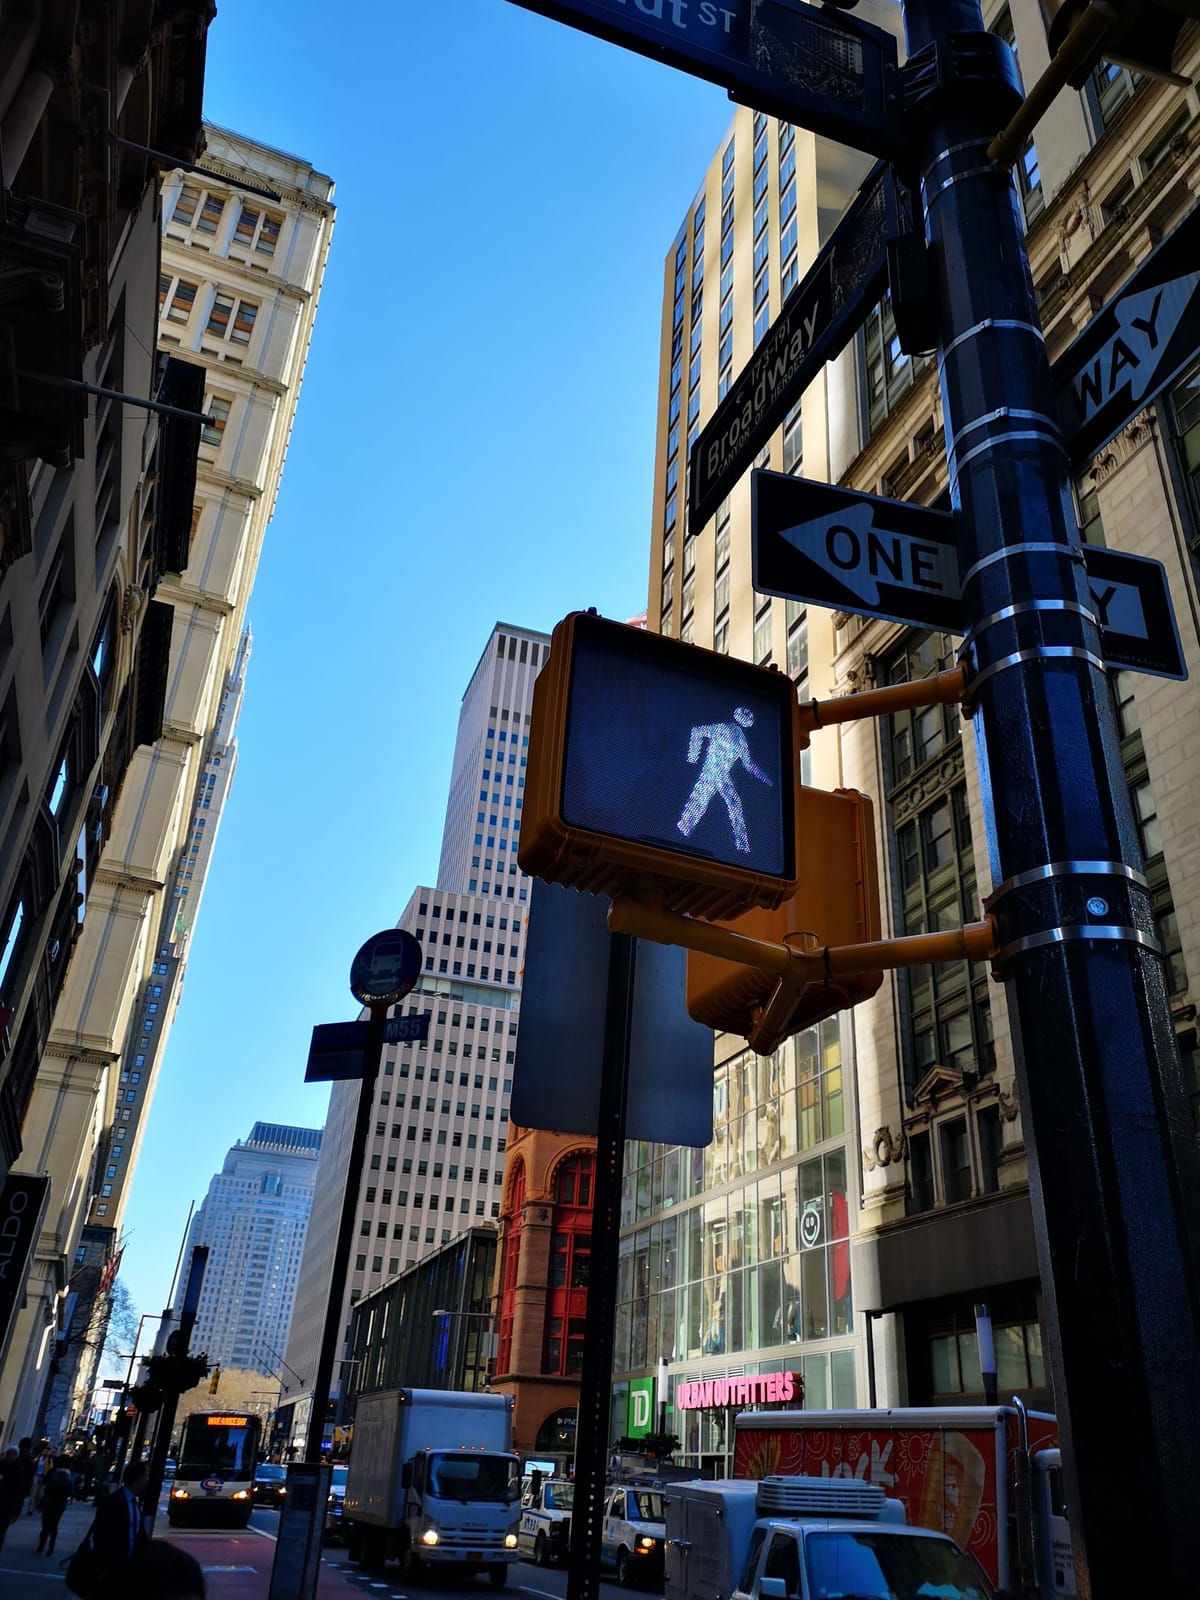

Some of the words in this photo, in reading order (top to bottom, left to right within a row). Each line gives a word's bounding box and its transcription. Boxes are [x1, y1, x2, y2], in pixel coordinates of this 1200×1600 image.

[698, 2, 737, 33] ST
[751, 317, 791, 386] 173-191
[1070, 288, 1164, 424] WAY
[707, 300, 819, 480] Broadway
[717, 429, 750, 477] CANYON
[754, 408, 766, 425] OF
[770, 349, 806, 403] HEROES
[825, 524, 943, 591] ONE
[385, 1018, 421, 1040] M55
[0, 1191, 29, 1279] ALDO
[631, 1390, 649, 1427] TD
[677, 1382, 713, 1410] URBAN
[713, 1371, 796, 1407] OUTFITTERS
